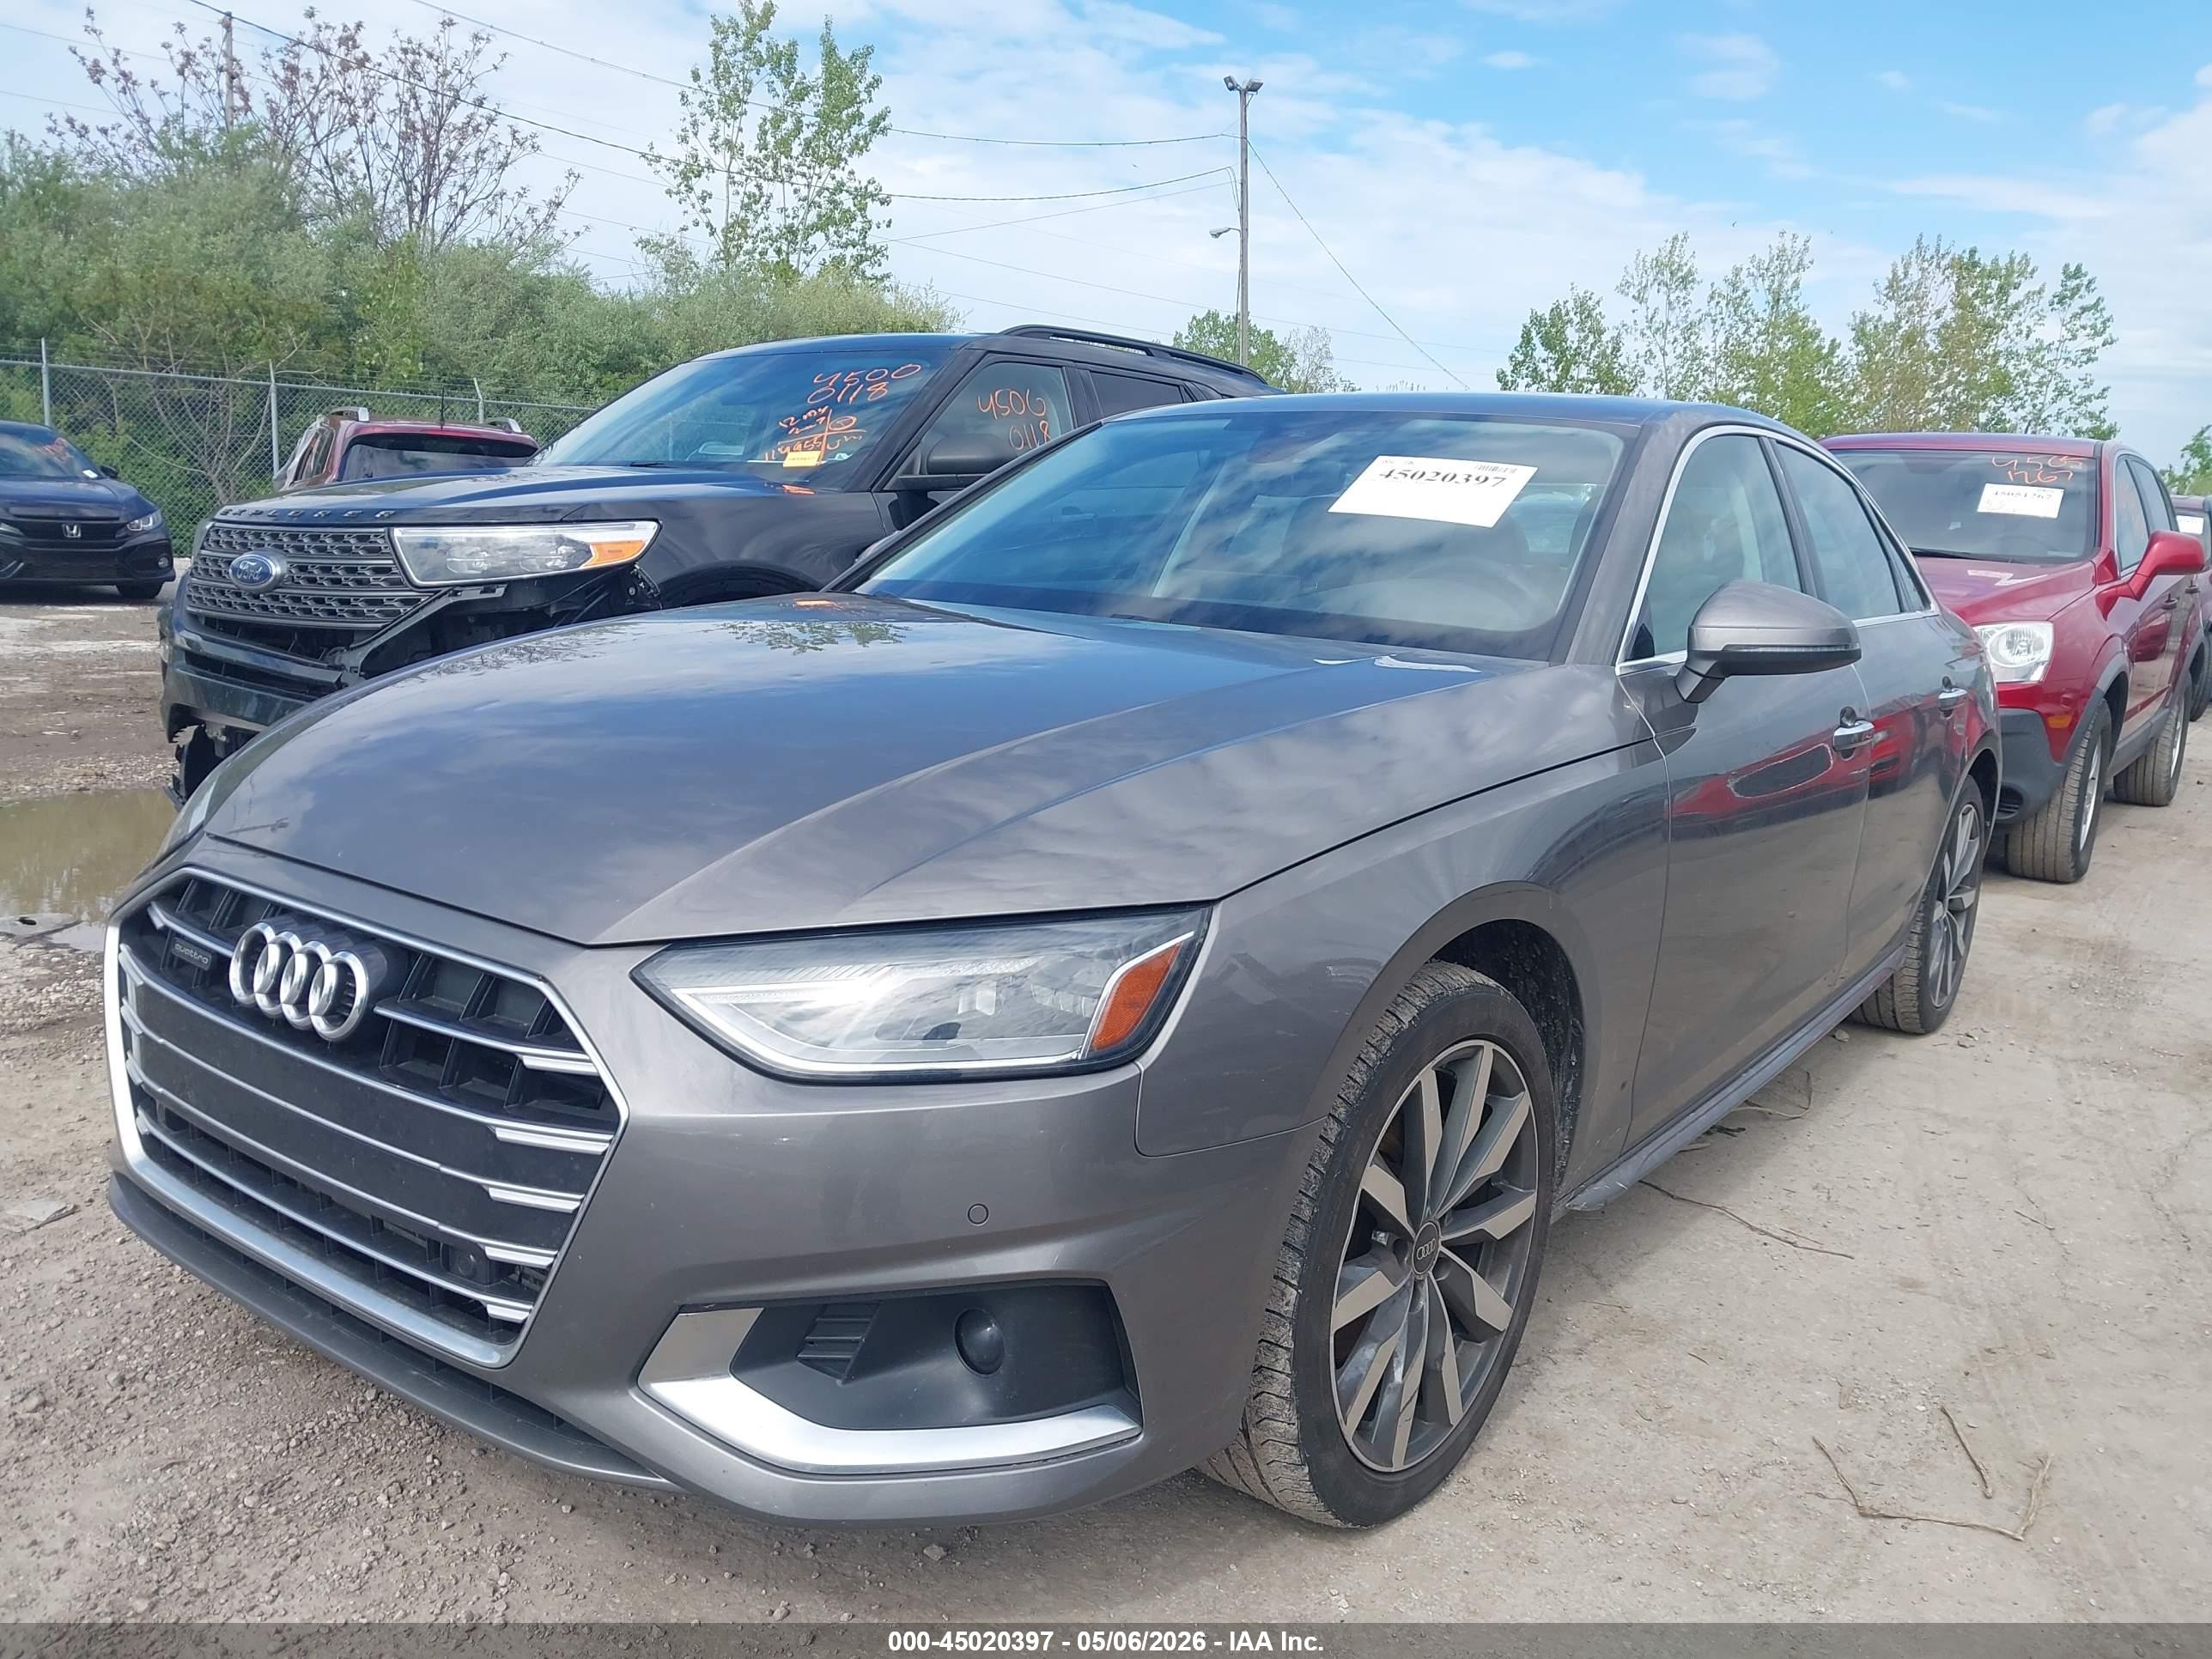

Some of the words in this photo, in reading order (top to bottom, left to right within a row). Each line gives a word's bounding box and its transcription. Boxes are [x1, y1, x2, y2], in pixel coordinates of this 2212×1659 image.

[806, 381, 890, 405] 0118
[1378, 468, 1508, 488] 45020397
[235, 560, 264, 580] Ford
[174, 943, 210, 964] quattro
